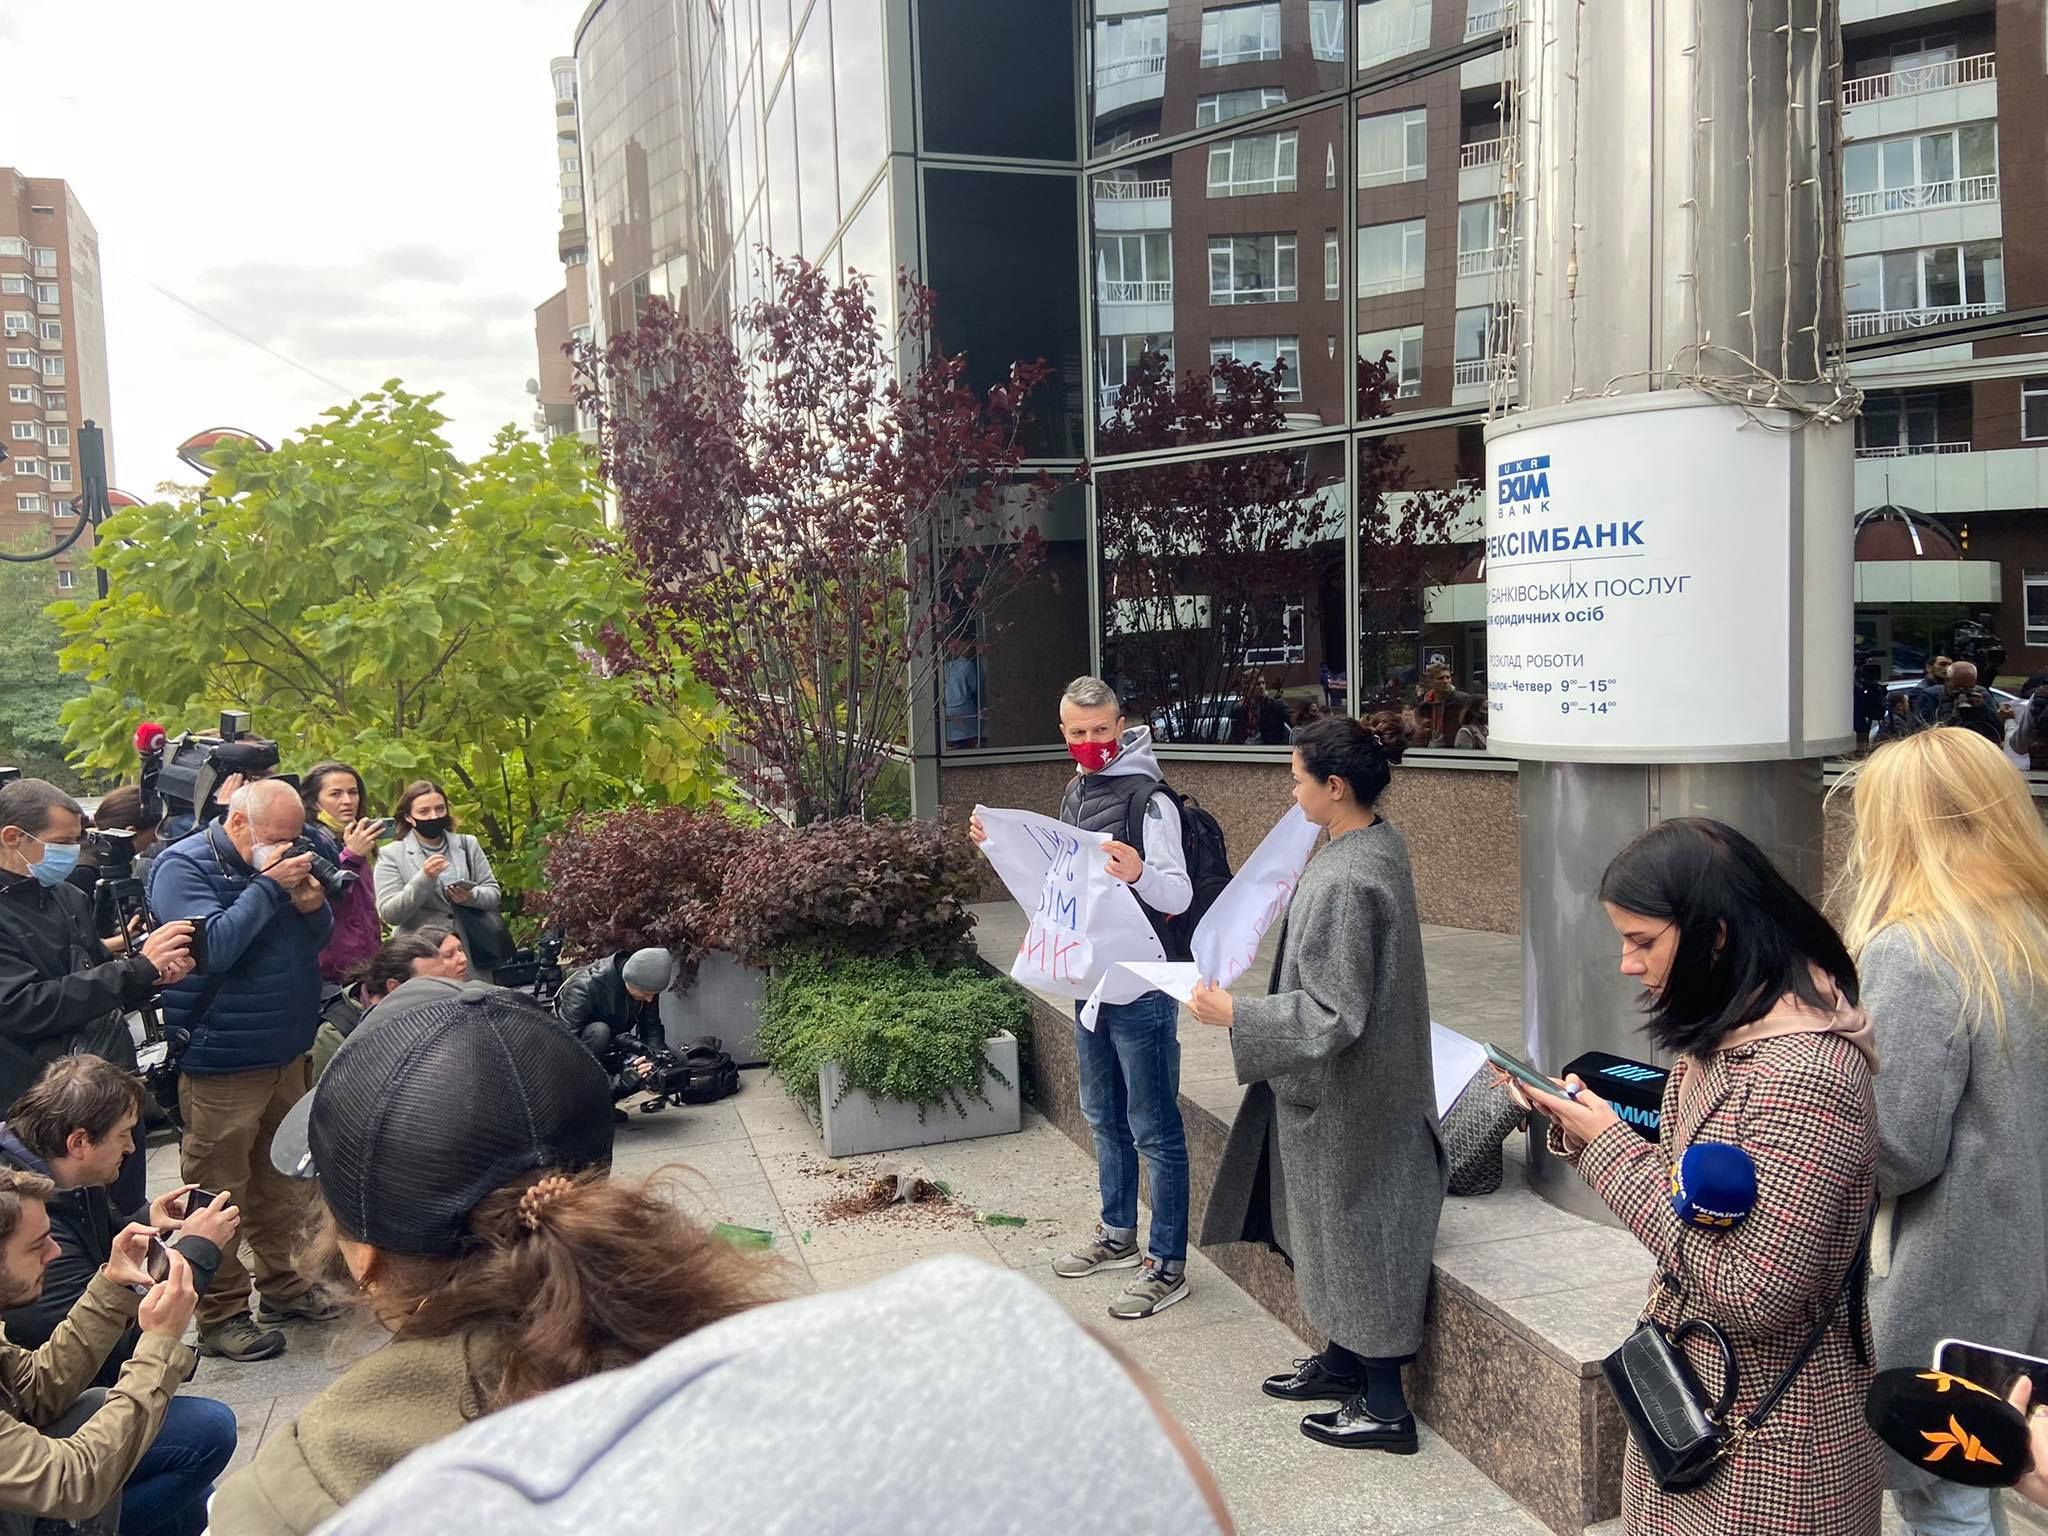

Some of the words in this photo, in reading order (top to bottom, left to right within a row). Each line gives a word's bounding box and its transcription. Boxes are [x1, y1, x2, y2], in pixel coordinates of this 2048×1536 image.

[1504, 459, 1538, 474] UKR
[1498, 472, 1550, 505] EXIM
[1498, 501, 1550, 519] BANK
[1491, 581, 1589, 603] БАНКІВСЬКИХ
[1594, 575, 1692, 597] ПОСЛУГ
[1494, 611, 1561, 628] юридичних
[1565, 605, 1604, 623] осіб
[1526, 653, 1584, 668] РОБОТИ
[1691, 1202, 1745, 1218] УКРАЇНА
[1693, 1213, 1733, 1227] 24
